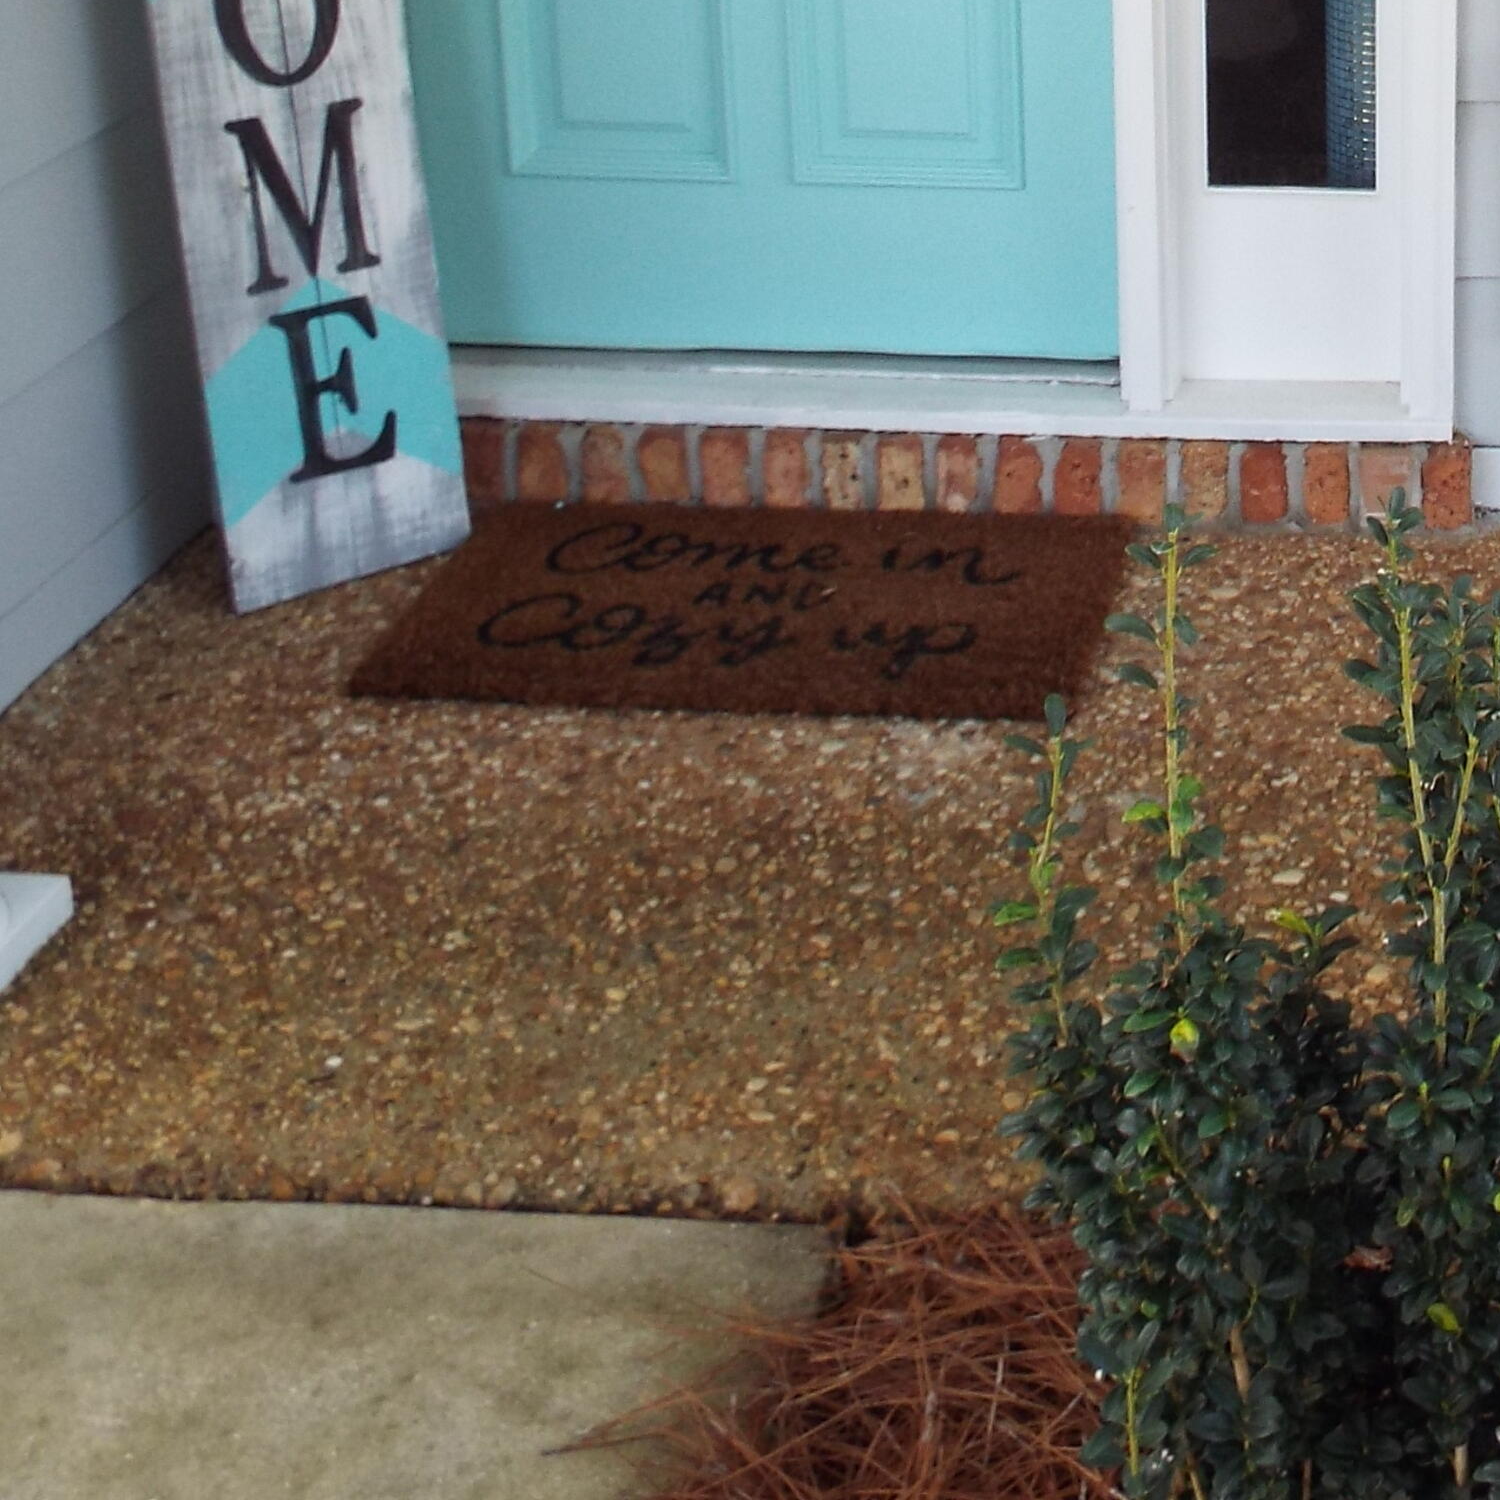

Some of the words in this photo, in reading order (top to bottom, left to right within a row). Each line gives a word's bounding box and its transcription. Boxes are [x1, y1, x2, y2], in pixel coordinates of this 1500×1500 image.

[545, 521, 850, 575] Come
[881, 539, 1021, 586] in
[693, 580, 836, 612] AND
[476, 592, 797, 667] Cozy
[829, 621, 977, 681] up
